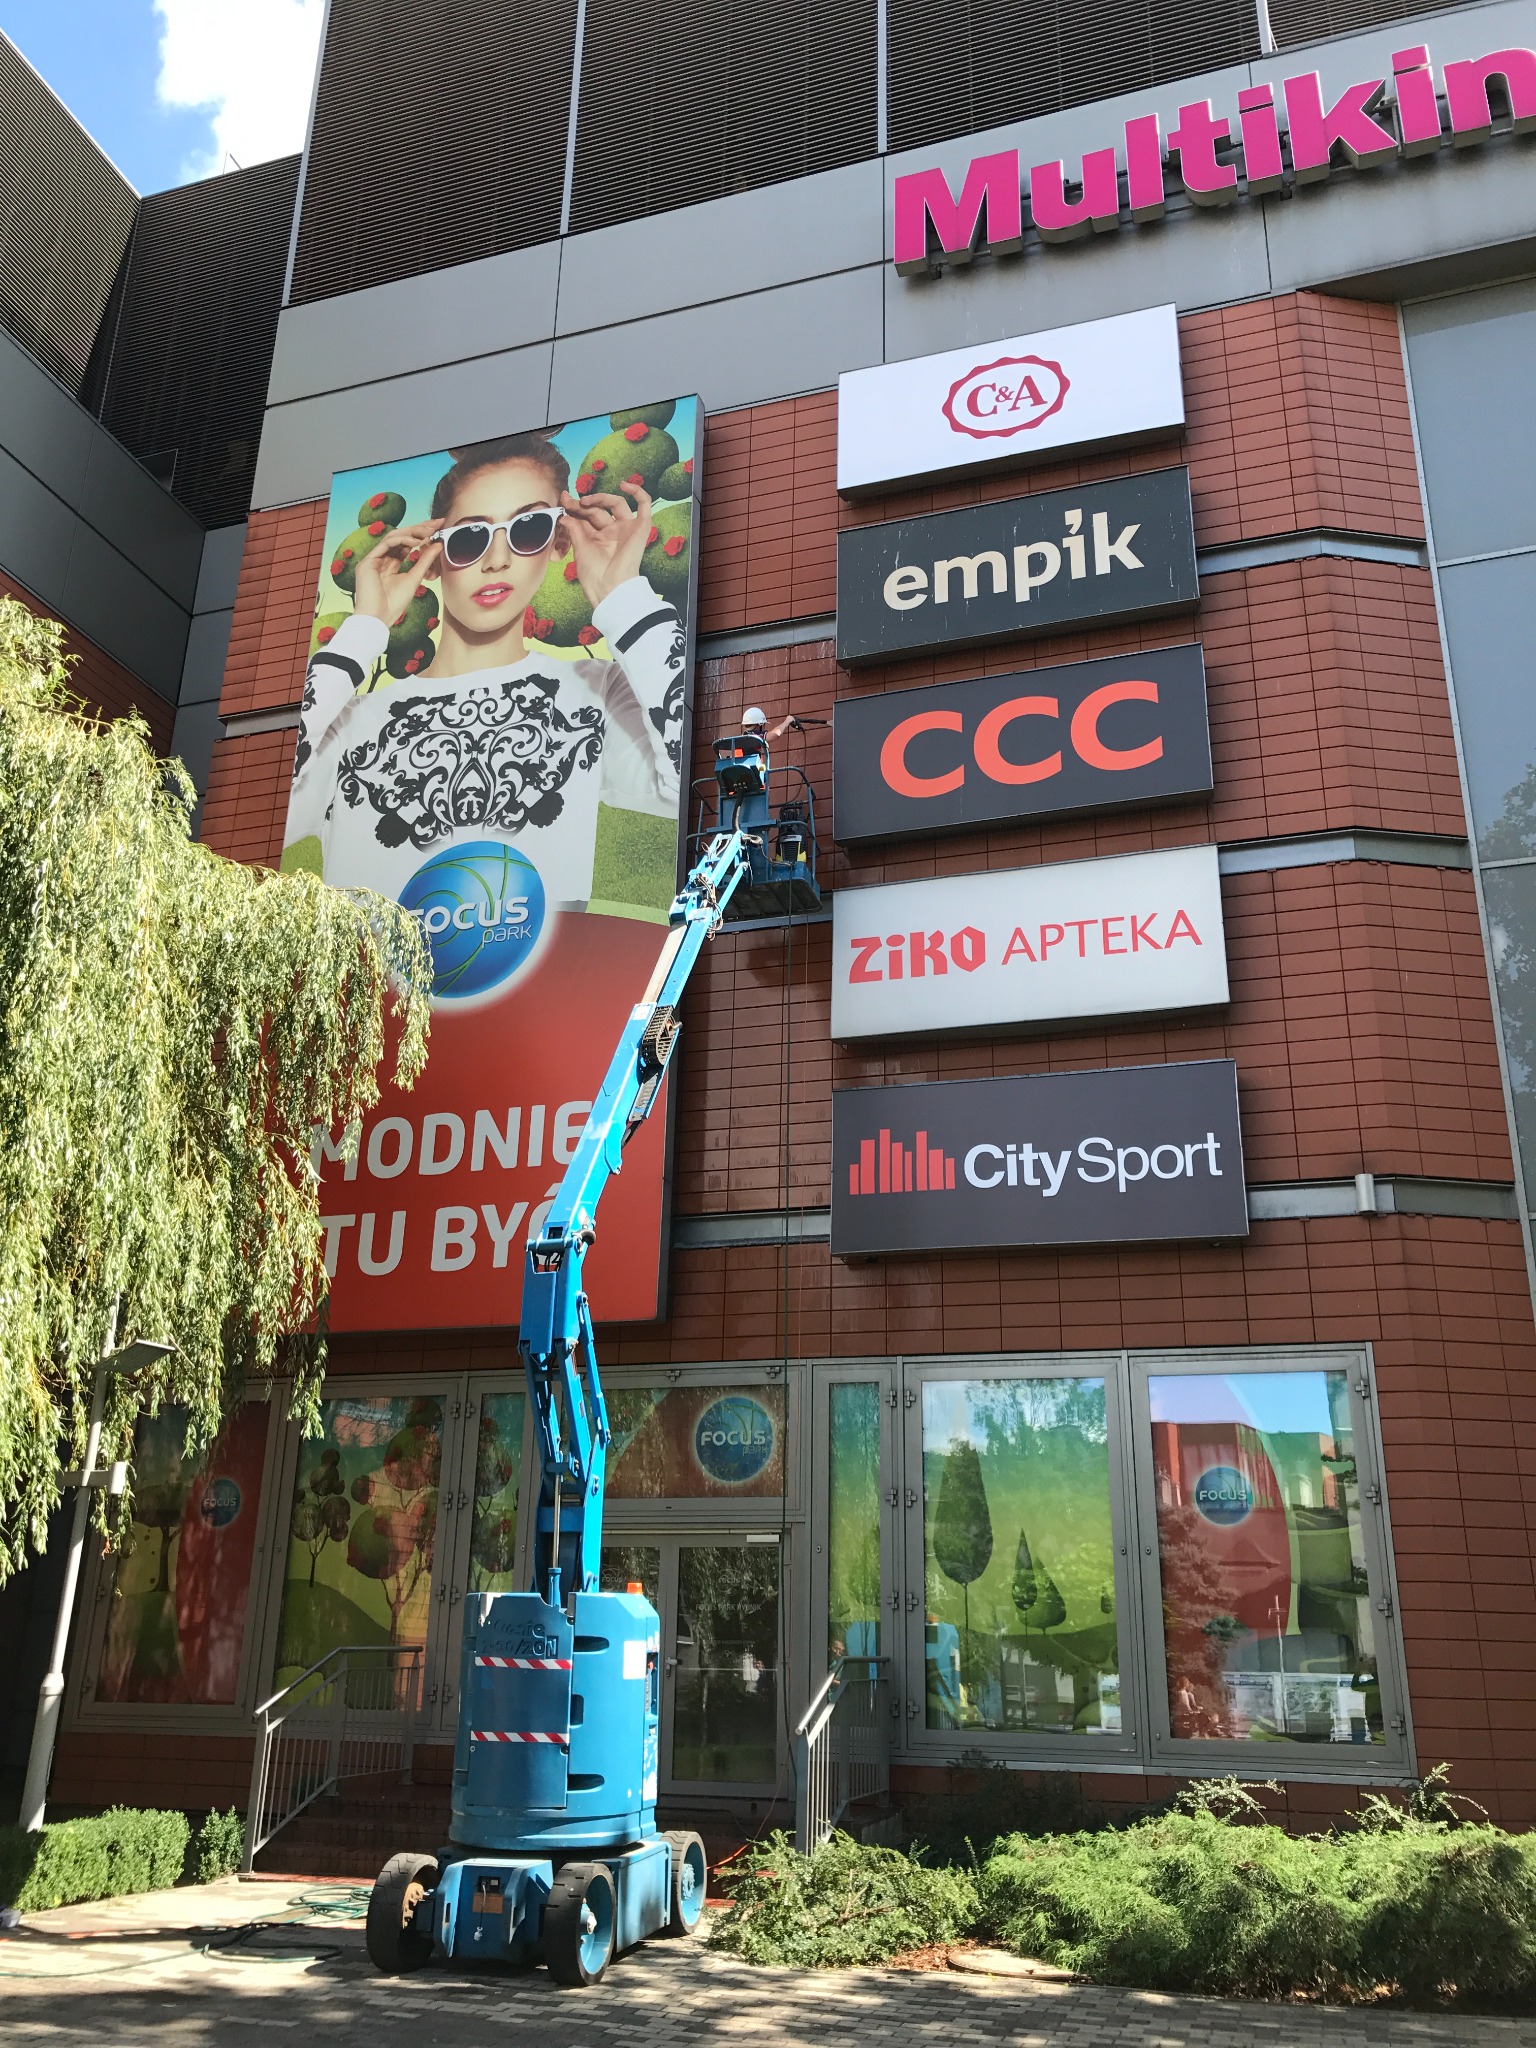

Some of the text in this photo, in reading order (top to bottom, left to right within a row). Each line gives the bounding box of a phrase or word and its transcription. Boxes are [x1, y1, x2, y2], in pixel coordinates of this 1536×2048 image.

[893, 44, 1536, 268] Multikin
[965, 375, 1048, 419] C&A
[883, 508, 1144, 611] empik
[880, 680, 1163, 798] CCC
[408, 896, 529, 934] OCUS
[1001, 909, 1202, 965] APTEKA
[309, 1100, 592, 1182] MODNIE
[319, 1210, 406, 1277] TU
[700, 1430, 766, 1446] FOCUS
[203, 1497, 237, 1507] FOCUS
[1199, 1489, 1247, 1501] FOCUS
